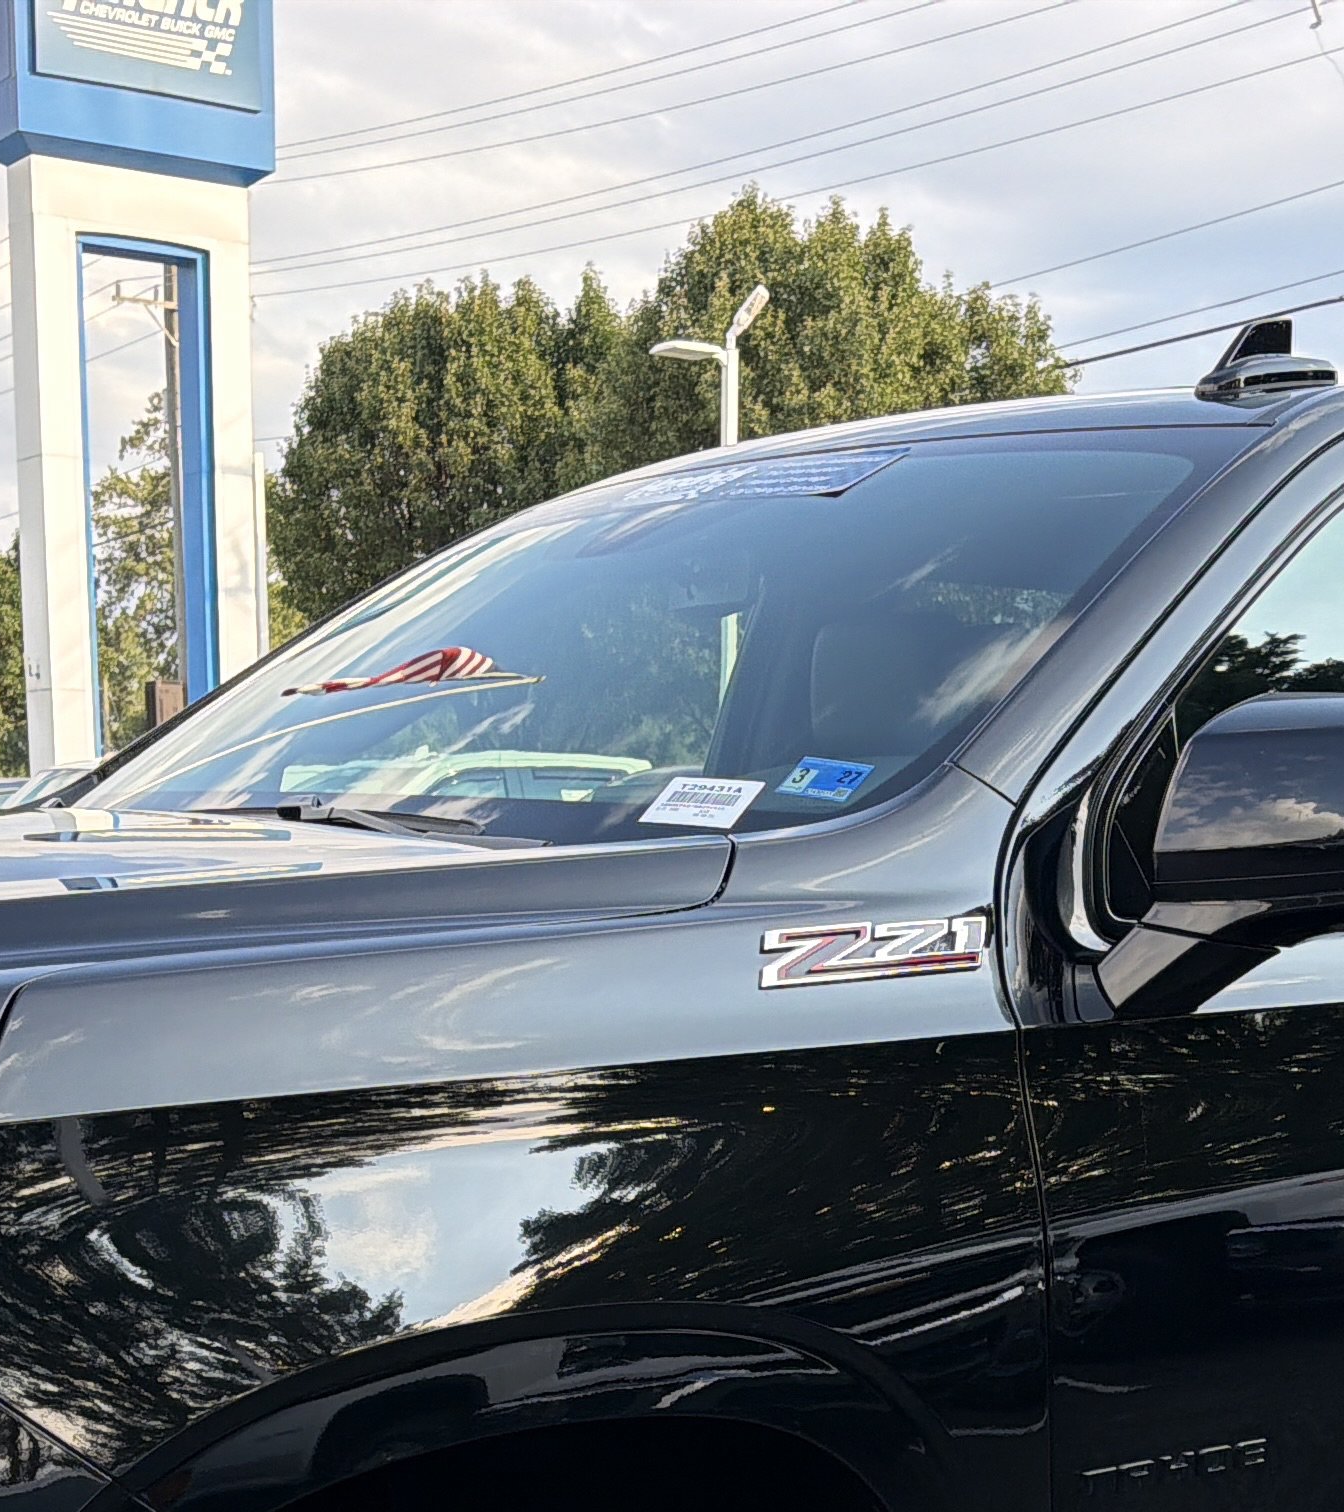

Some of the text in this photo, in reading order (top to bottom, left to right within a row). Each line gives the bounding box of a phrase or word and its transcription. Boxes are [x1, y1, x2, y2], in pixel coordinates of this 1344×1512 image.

[80, 1, 237, 42] CHEVROLET BUICK GMC
[792, 767, 864, 785] 3 27
[759, 916, 987, 989] Z71
